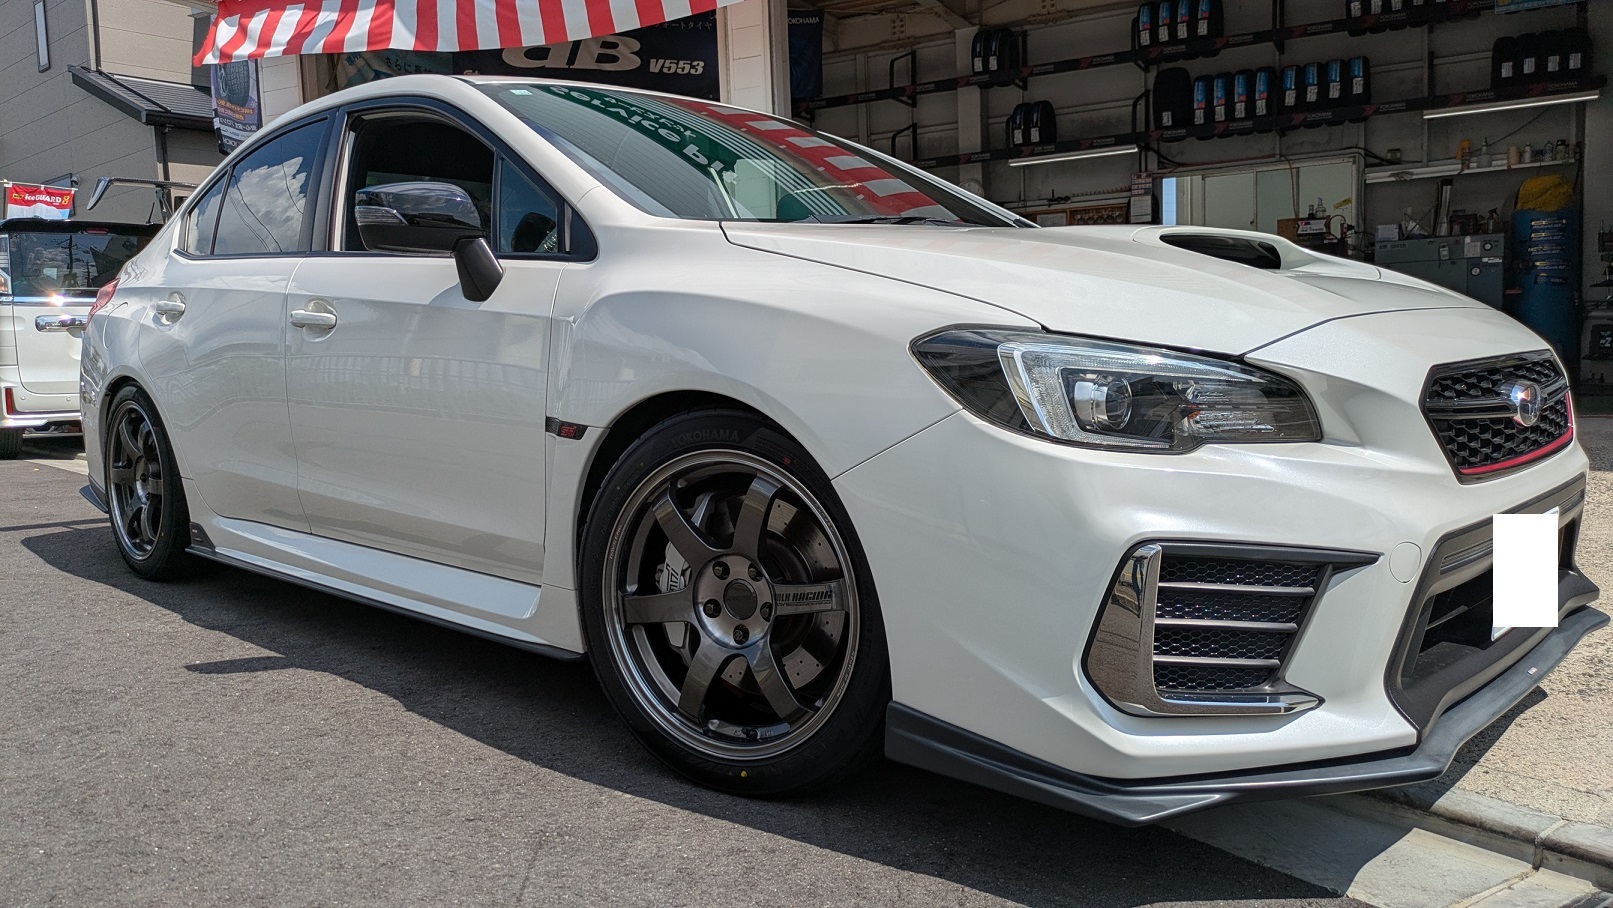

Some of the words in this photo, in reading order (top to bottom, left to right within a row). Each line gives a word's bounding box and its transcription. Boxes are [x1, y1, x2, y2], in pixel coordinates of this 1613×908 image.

[787, 16, 820, 25] OKOHAMA
[649, 58, 705, 75] V553
[24, 193, 62, 203] iceGUARD
[671, 428, 739, 448] YOKOHAMA
